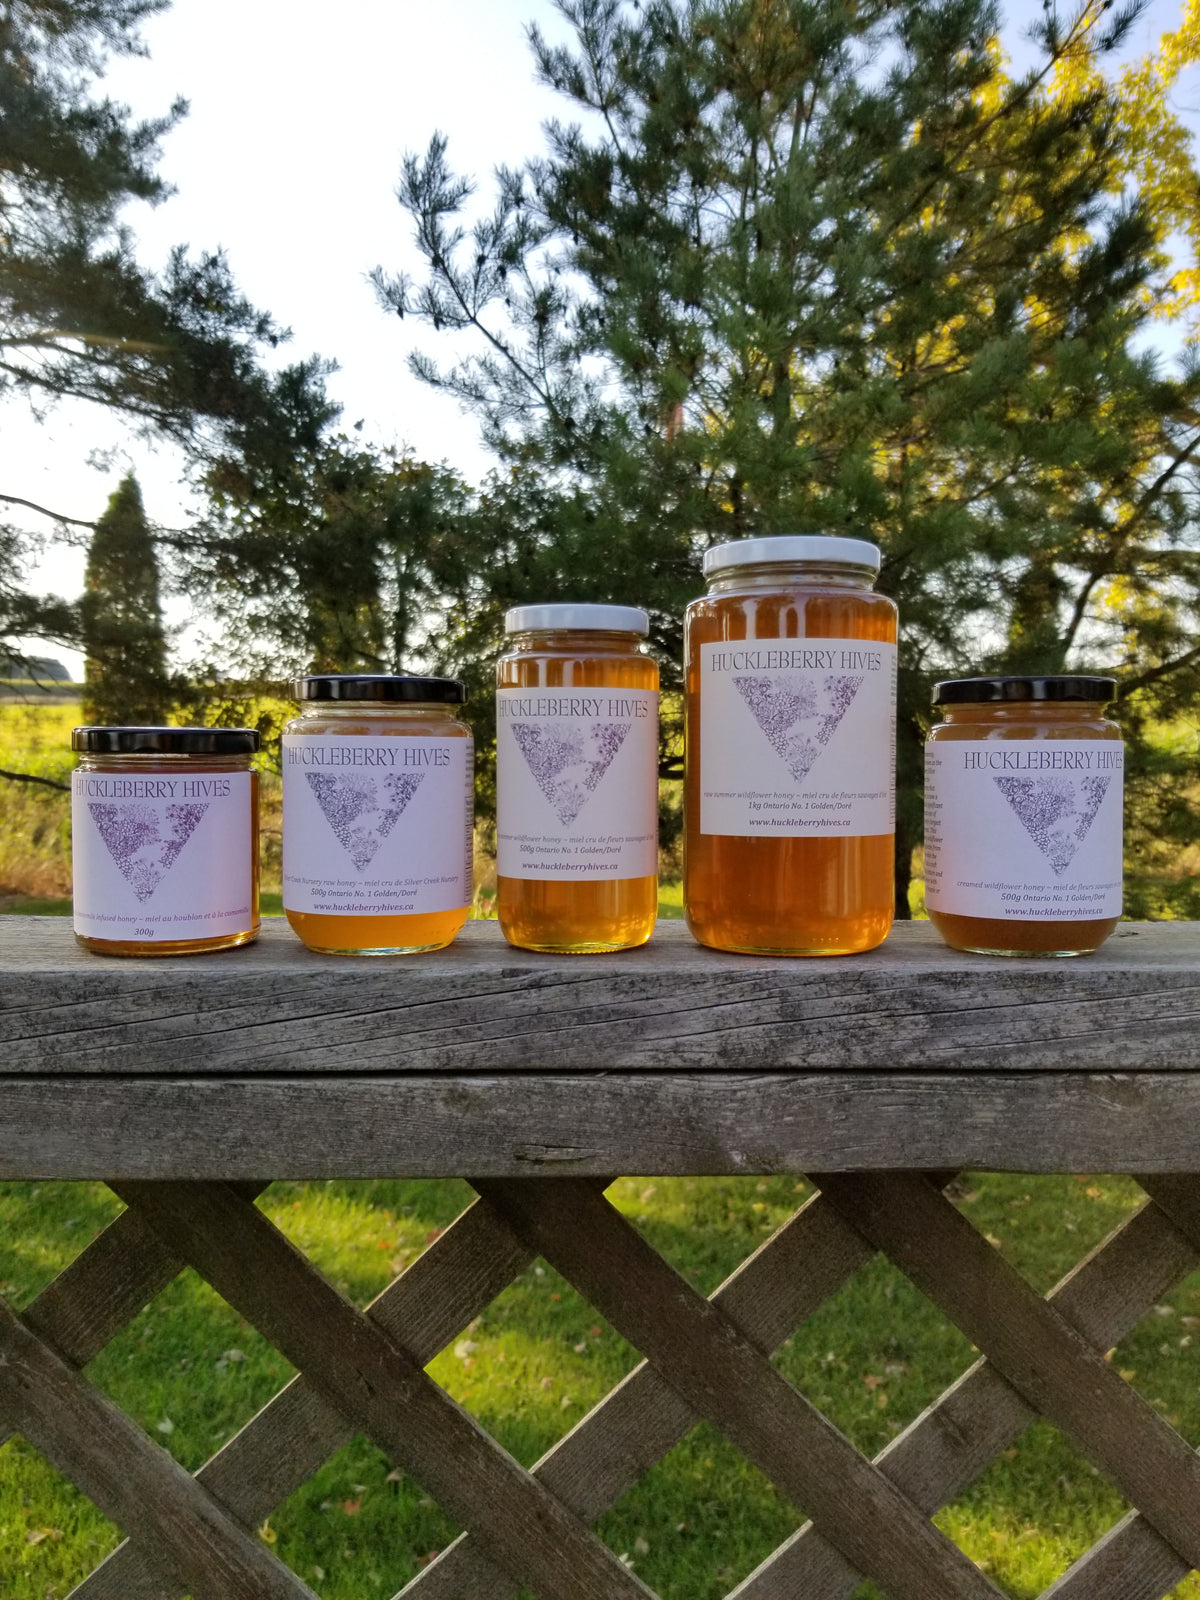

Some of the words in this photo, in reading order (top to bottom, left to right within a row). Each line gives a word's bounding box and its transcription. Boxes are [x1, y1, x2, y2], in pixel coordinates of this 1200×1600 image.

[711, 649, 837, 672] HUCKLEBERRY
[840, 650, 882, 671] HIVES
[499, 698, 604, 717] HUCKLEBERRY
[607, 699, 649, 718] HIVES
[288, 746, 399, 766] HUCKLEBERRY
[403, 748, 450, 767] HIVES
[963, 750, 1094, 770] HUCKLEBERRY
[76, 779, 178, 799] HUCKLEBERRY
[183, 779, 231, 797] HIVES
[737, 792, 772, 800] wildflower
[773, 792, 795, 801] honey
[831, 791, 839, 799] de
[748, 801, 762, 811] 1kg
[762, 802, 790, 810] Ontario
[791, 802, 803, 810] No.
[804, 802, 809, 810] 1
[749, 818, 851, 828] www.huckleberryhives.ca
[520, 844, 535, 854] 500g
[535, 845, 560, 854] Ontario
[522, 862, 618, 872] www.huckleberryhives.ca
[336, 880, 357, 889] honey
[364, 879, 379, 887] miel
[394, 879, 403, 887] de
[403, 878, 424, 887] Silver
[956, 880, 983, 889] creamed
[984, 881, 1021, 891] wildflower
[1022, 883, 1046, 893] honey
[1052, 883, 1068, 891] miel
[1069, 882, 1076, 891] de
[310, 887, 327, 898] 500g
[327, 888, 353, 897] Ontario
[354, 889, 366, 898] No.
[367, 890, 372, 898] 1
[373, 888, 418, 898] Golden/Doré
[1000, 892, 1021, 902] 500g
[1022, 894, 1051, 902] Ontario
[1065, 894, 1070, 902] 1
[313, 903, 414, 913] www.huckleberryhives.ca
[1004, 907, 1104, 917] www.huckleberryhives.ca
[117, 914, 138, 924] honey
[144, 914, 161, 922] miel
[173, 913, 203, 922] houblon
[203, 912, 212, 920] et
[134, 928, 154, 938] 300g
